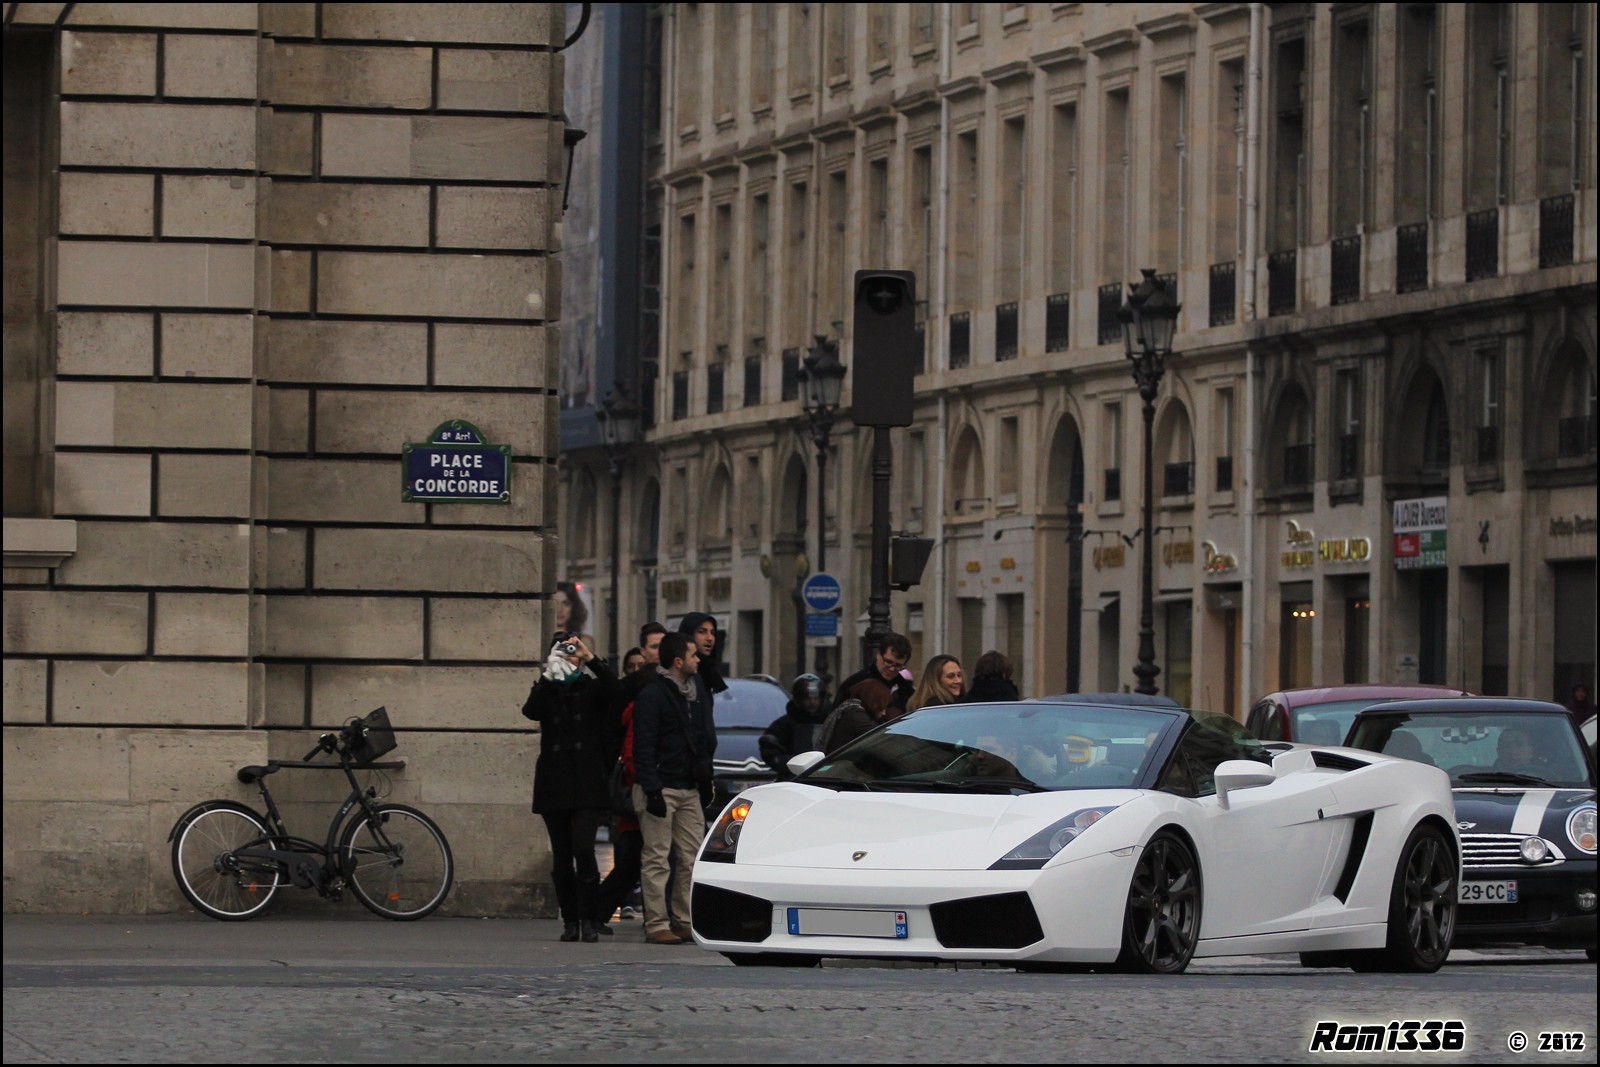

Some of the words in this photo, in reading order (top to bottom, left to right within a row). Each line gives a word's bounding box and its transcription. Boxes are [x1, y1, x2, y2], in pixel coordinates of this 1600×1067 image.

[430, 454, 483, 468] PLACE
[443, 469, 454, 477] DE
[415, 479, 499, 493] CONCORDE
[1507, 891, 1517, 900] 75
[896, 926, 906, 935] 94
